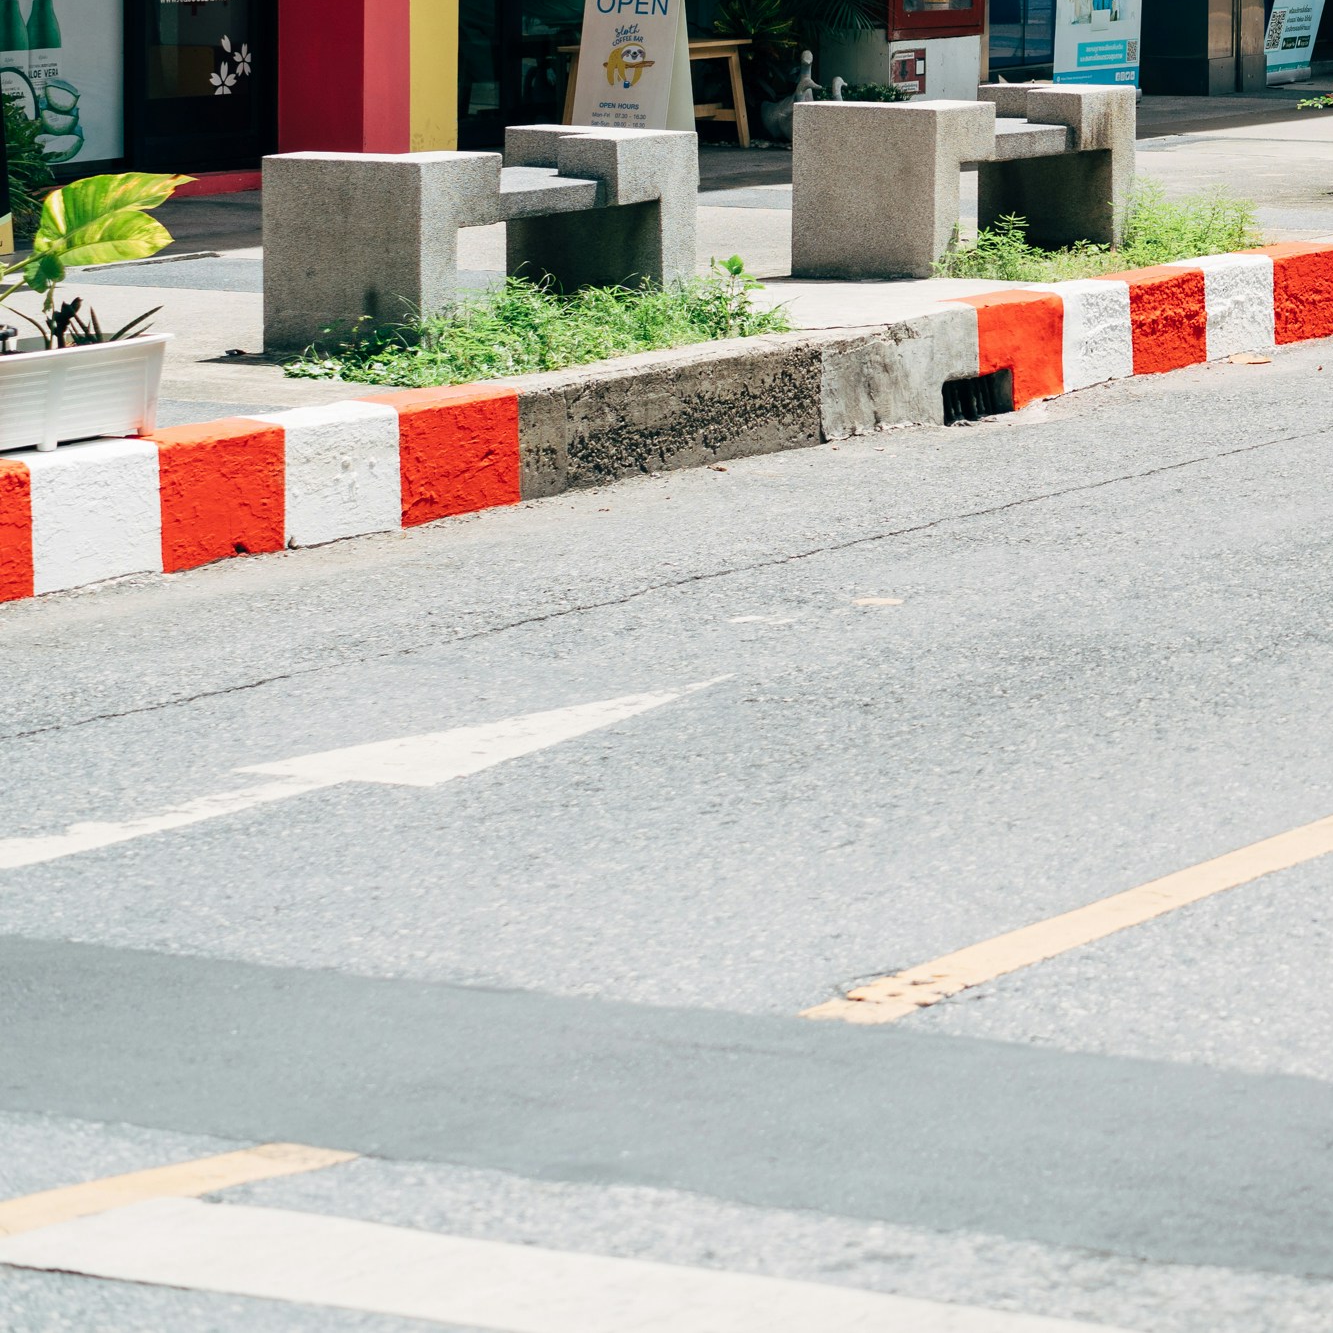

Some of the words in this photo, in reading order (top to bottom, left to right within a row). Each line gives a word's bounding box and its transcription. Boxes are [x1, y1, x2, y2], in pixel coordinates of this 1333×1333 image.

[614, 23, 640, 38] Sloth
[612, 35, 632, 46] COFFEE
[633, 35, 644, 43] BAR
[618, 102, 640, 110] HOURS
